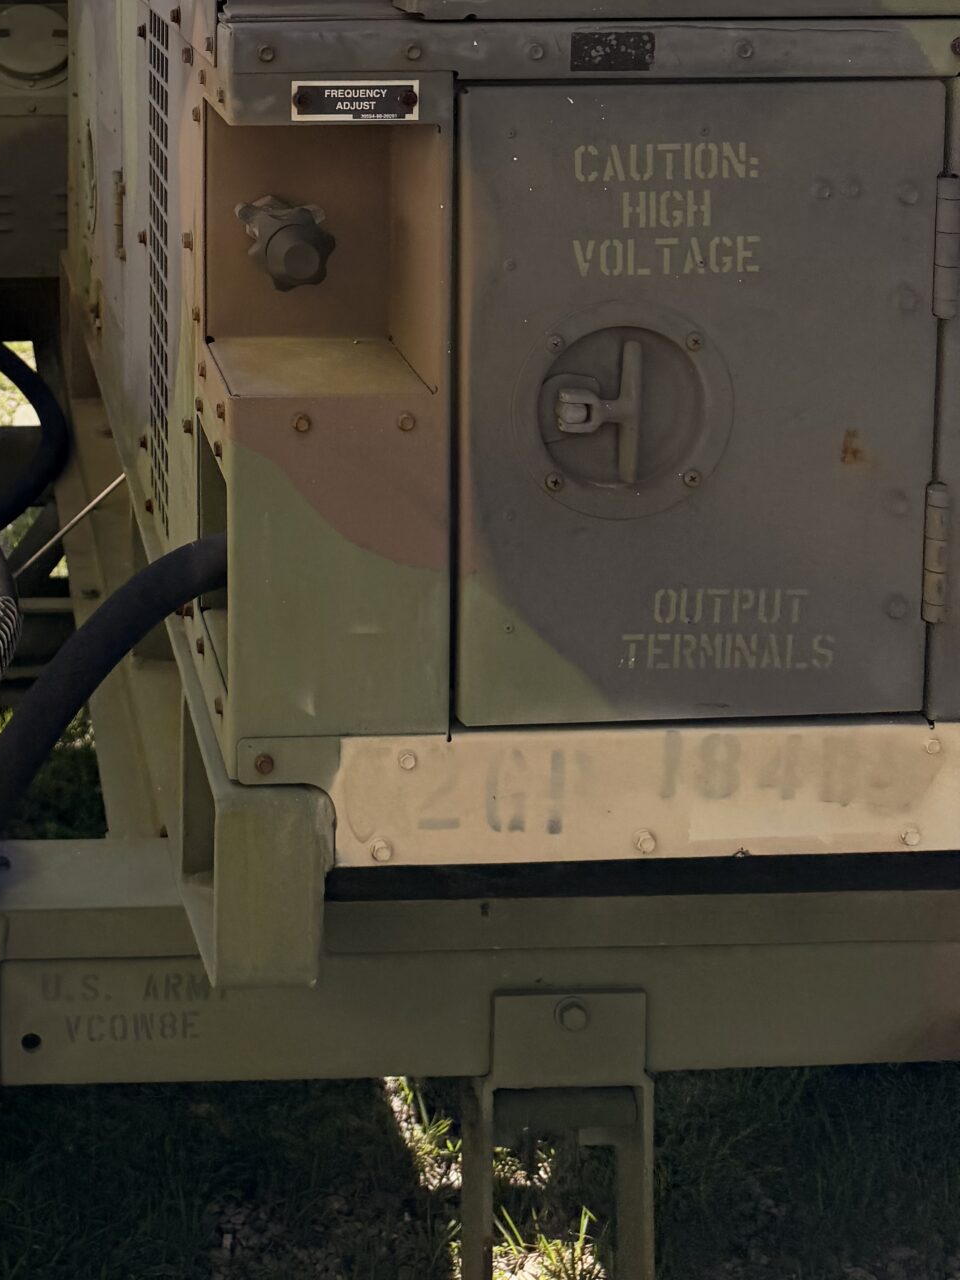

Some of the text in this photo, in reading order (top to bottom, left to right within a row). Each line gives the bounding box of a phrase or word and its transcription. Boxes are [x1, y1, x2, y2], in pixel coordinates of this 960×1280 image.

[324, 89, 388, 98] FREQUENCY
[335, 101, 376, 110] ADJUST
[574, 142, 760, 182] CAUTION:
[622, 190, 711, 228] HIGH
[572, 236, 761, 277] VOLTAGE
[653, 588, 809, 624] OUTPUT
[621, 633, 836, 669] TERMINALS
[42, 973, 113, 1002] U.S.
